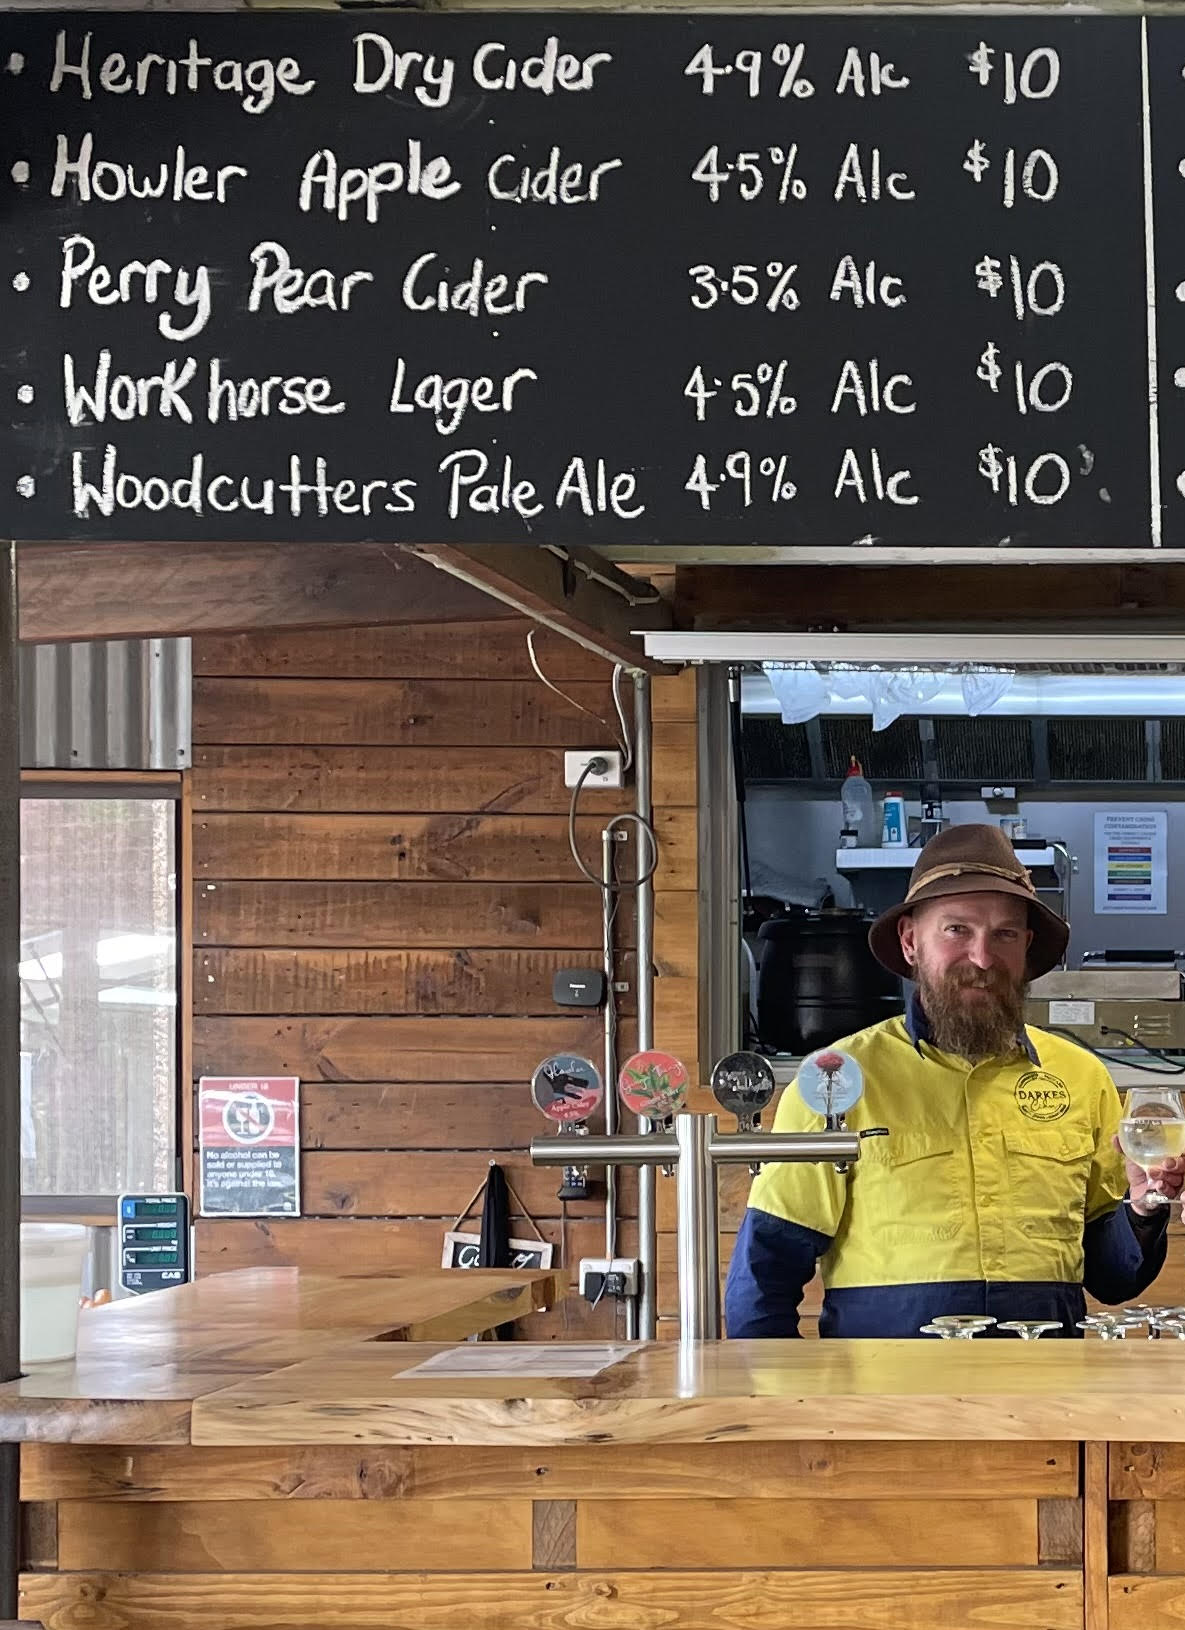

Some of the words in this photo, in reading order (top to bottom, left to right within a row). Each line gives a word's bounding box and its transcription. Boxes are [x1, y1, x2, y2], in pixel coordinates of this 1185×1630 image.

[50, 30, 316, 114] Heritage
[352, 32, 455, 108] Dry
[472, 36, 612, 95] Cider
[684, 43, 815, 98] 4.9%
[835, 46, 910, 98] Alc
[968, 41, 1060, 105] $10
[50, 132, 248, 203] Howler
[299, 138, 462, 223] Apple
[487, 146, 623, 205] Cider
[834, 142, 916, 203] Alc
[962, 139, 1059, 209] $10
[59, 233, 211, 342] Perry
[248, 241, 374, 314] Pear
[402, 252, 549, 317] Cider
[688, 261, 800, 313] 3.5%
[829, 255, 907, 309] Alc
[975, 254, 1065, 321] $10
[389, 357, 538, 436] Lager
[830, 359, 916, 417] Alc
[976, 341, 1073, 415] $10
[72, 443, 417, 519] Woodcutters
[438, 448, 545, 519] Pale
[555, 456, 646, 519] Ale
[684, 450, 797, 511] 4.9%
[834, 448, 919, 505] Alc
[978, 442, 1070, 506] $10
[1018, 1090, 1066, 1100] DARKES
[207, 1151, 219, 1159] No
[221, 1151, 251, 1159] alcohol
